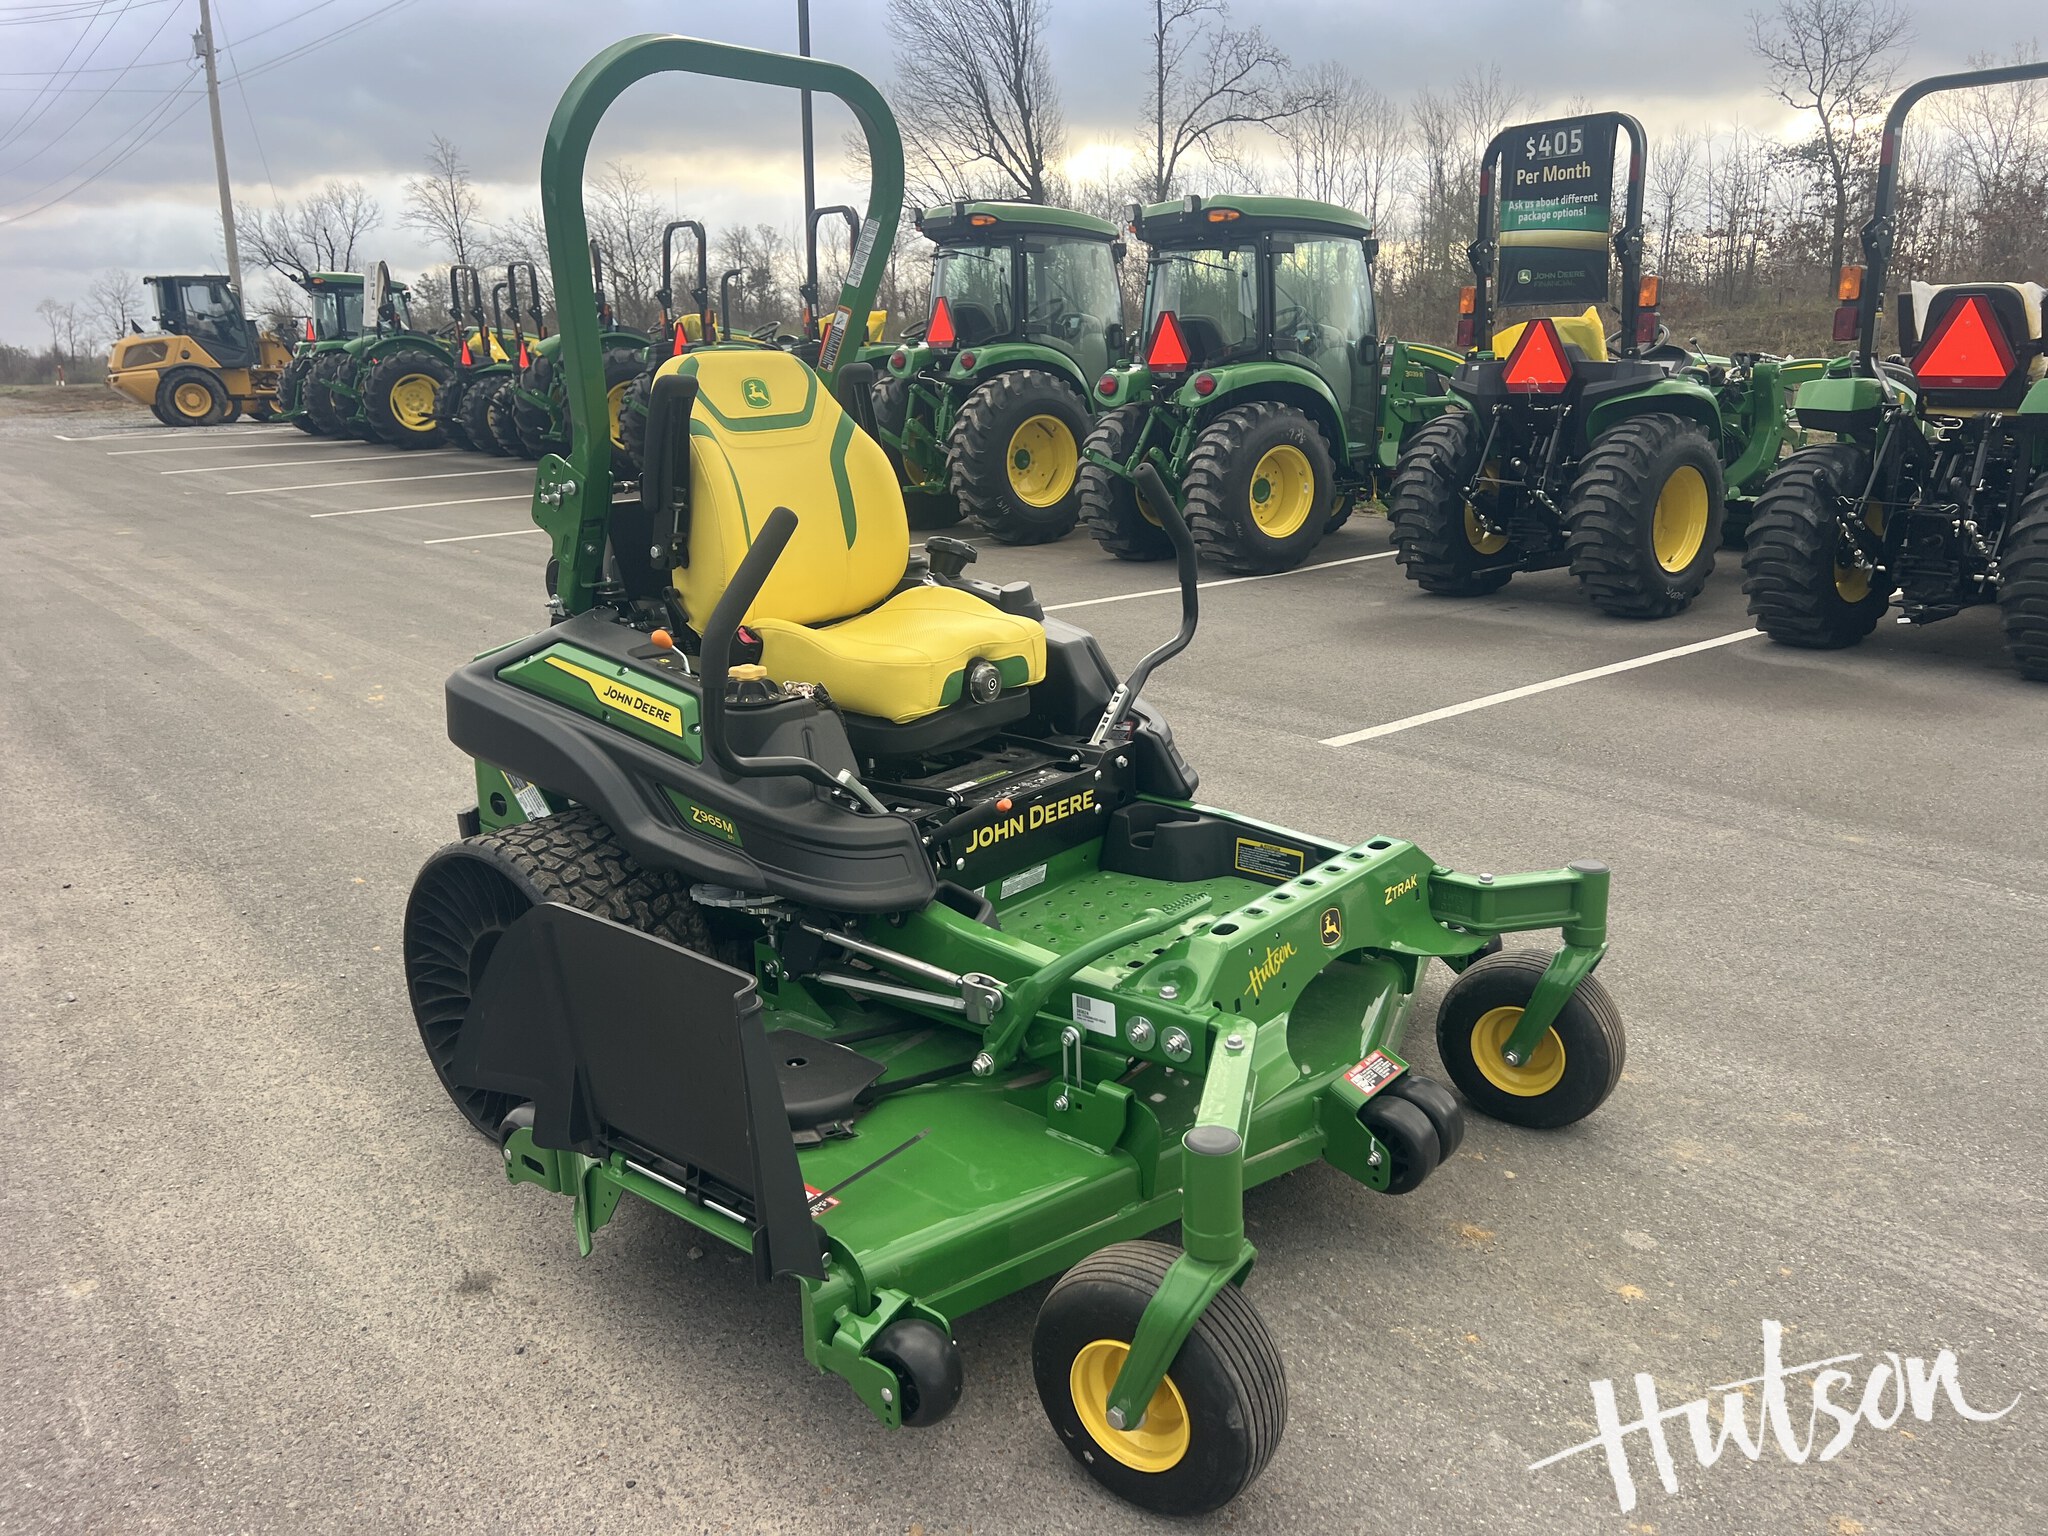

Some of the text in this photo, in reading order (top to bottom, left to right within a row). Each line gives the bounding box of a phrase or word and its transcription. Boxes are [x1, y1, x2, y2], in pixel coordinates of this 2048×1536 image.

[1526, 129, 1582, 160] $405
[1516, 161, 1591, 186] Per Month
[1508, 193, 1598, 211] Ask us about different
[1518, 206, 1587, 225] package options!
[603, 686, 672, 723] JOHN DEERE
[690, 806, 734, 834] Z965M
[966, 789, 1095, 854] JOHN DEERE
[1384, 873, 1418, 906] ZTRAK
[1244, 941, 1298, 998] Hutson
